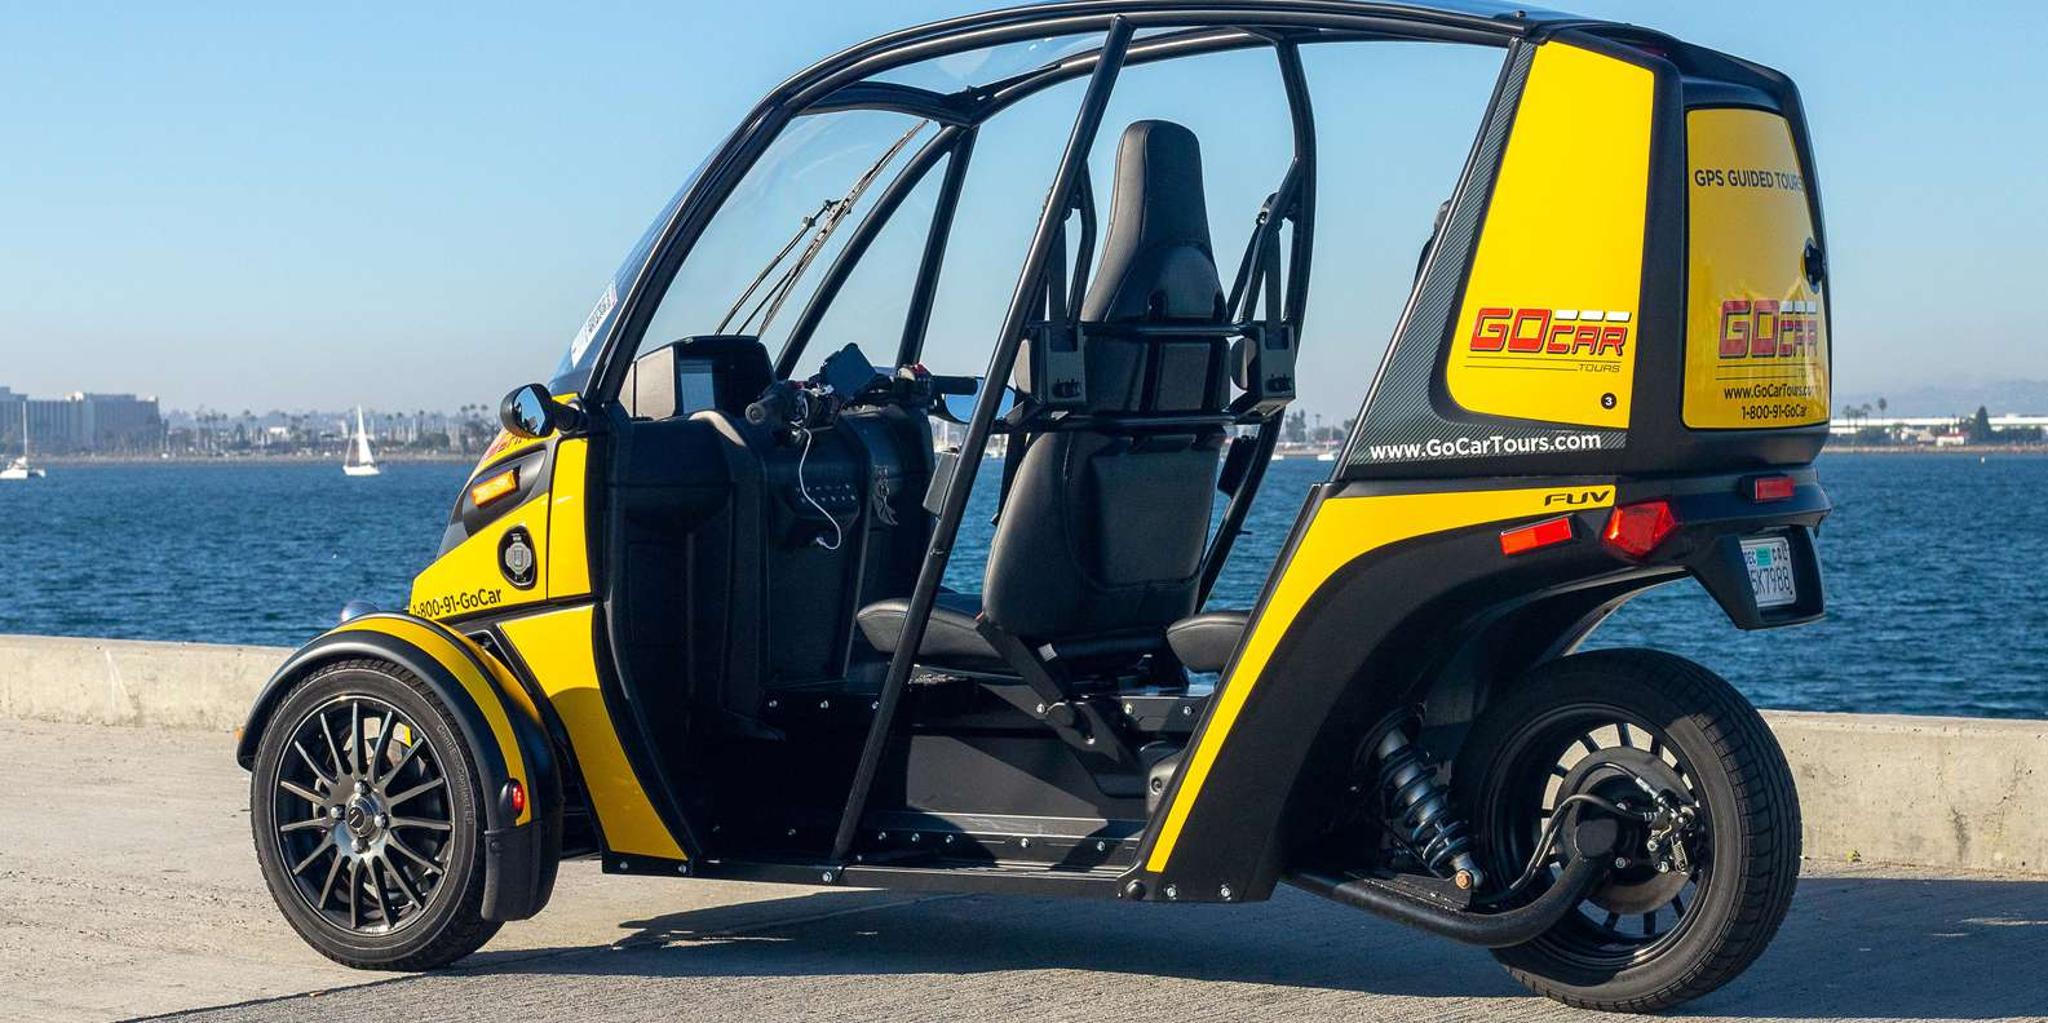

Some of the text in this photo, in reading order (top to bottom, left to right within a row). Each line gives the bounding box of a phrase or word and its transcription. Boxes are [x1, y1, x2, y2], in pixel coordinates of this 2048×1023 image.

[1694, 169, 1725, 187] GPS
[1728, 170, 1774, 188] GUIDED
[1577, 363, 1621, 374] TOURS
[1724, 383, 1816, 399] www.GoCarTours.co
[1741, 403, 1807, 420] 1-800-91-GoCar
[1369, 433, 1602, 460] www.GoCarTours.com
[1544, 490, 1610, 507] FUV
[413, 588, 501, 617] 1-800-91-GoCar
